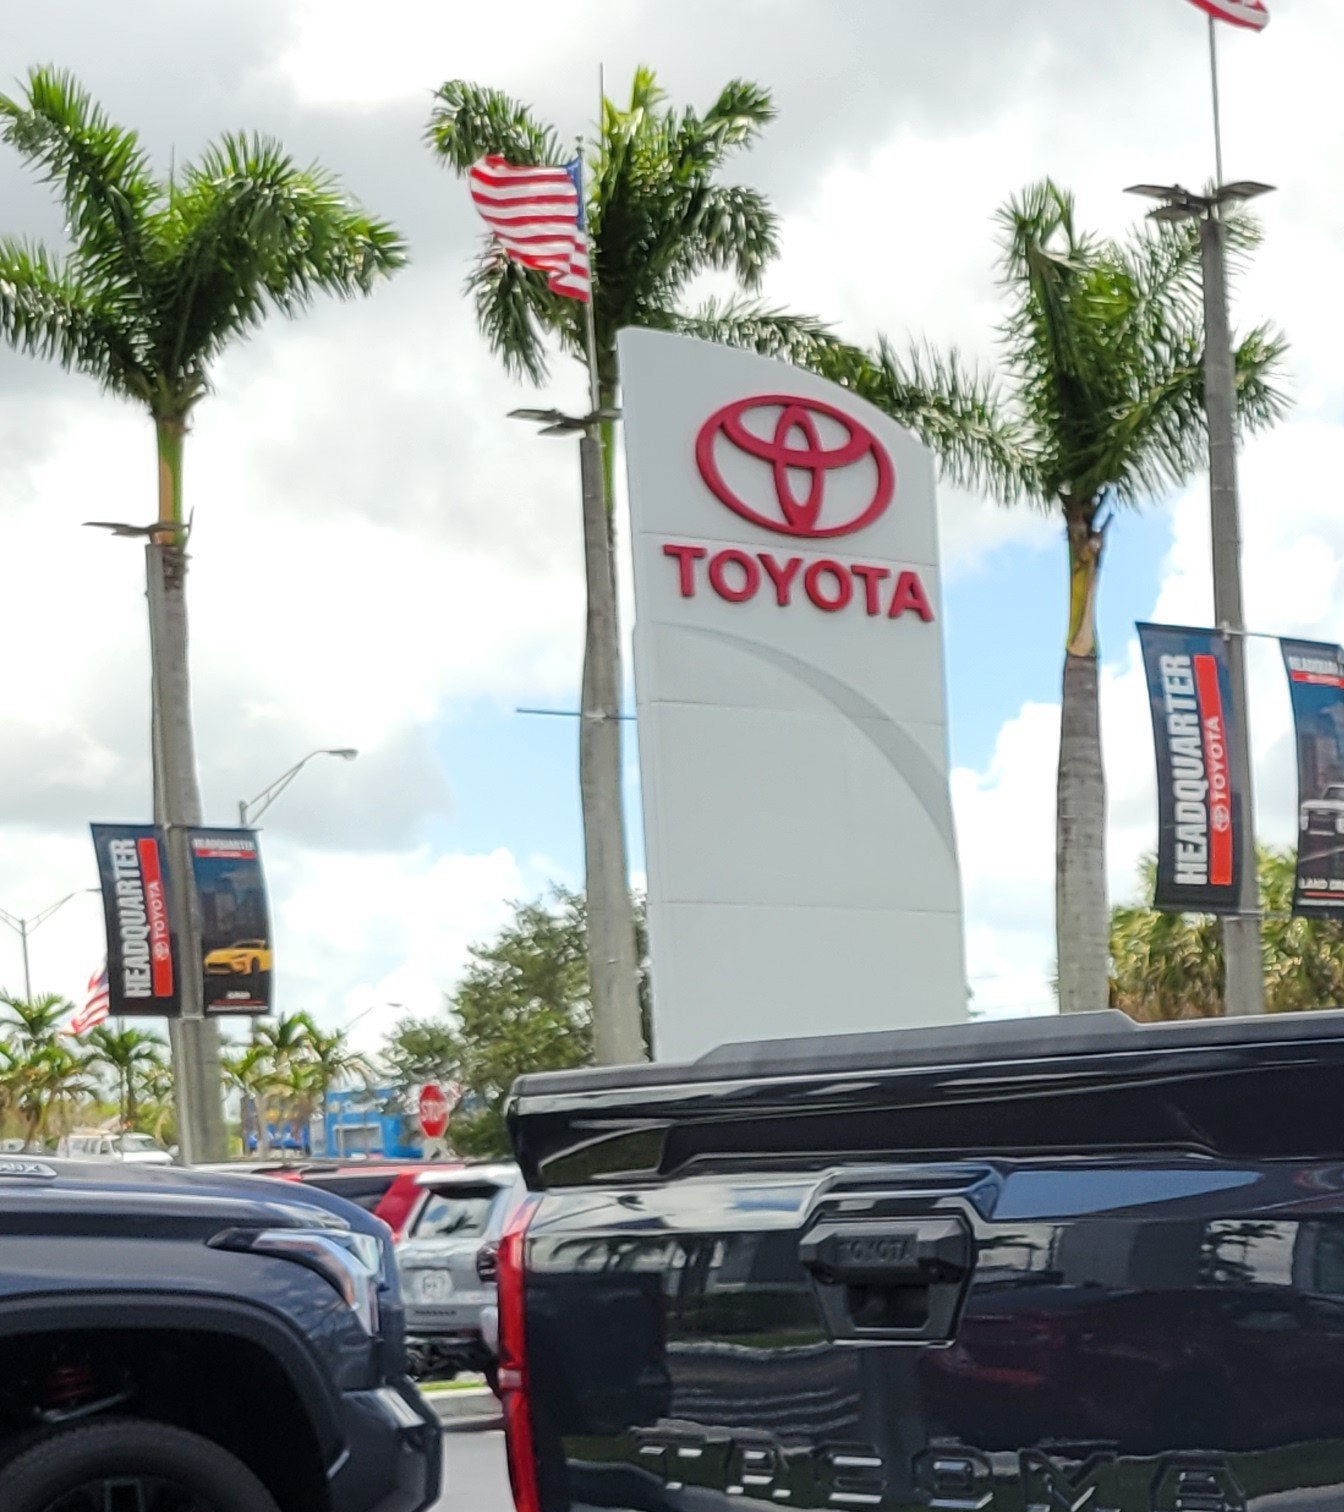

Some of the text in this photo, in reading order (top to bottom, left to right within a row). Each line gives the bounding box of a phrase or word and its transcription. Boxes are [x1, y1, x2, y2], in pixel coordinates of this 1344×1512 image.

[662, 544, 935, 622] TOYOTA
[1159, 654, 1210, 885] HEADQUARTER
[1204, 715, 1229, 802] TOYOTA
[109, 838, 153, 998] HEADQUARTER
[148, 881, 170, 943] TOYOTA
[421, 1100, 448, 1121] STOP
